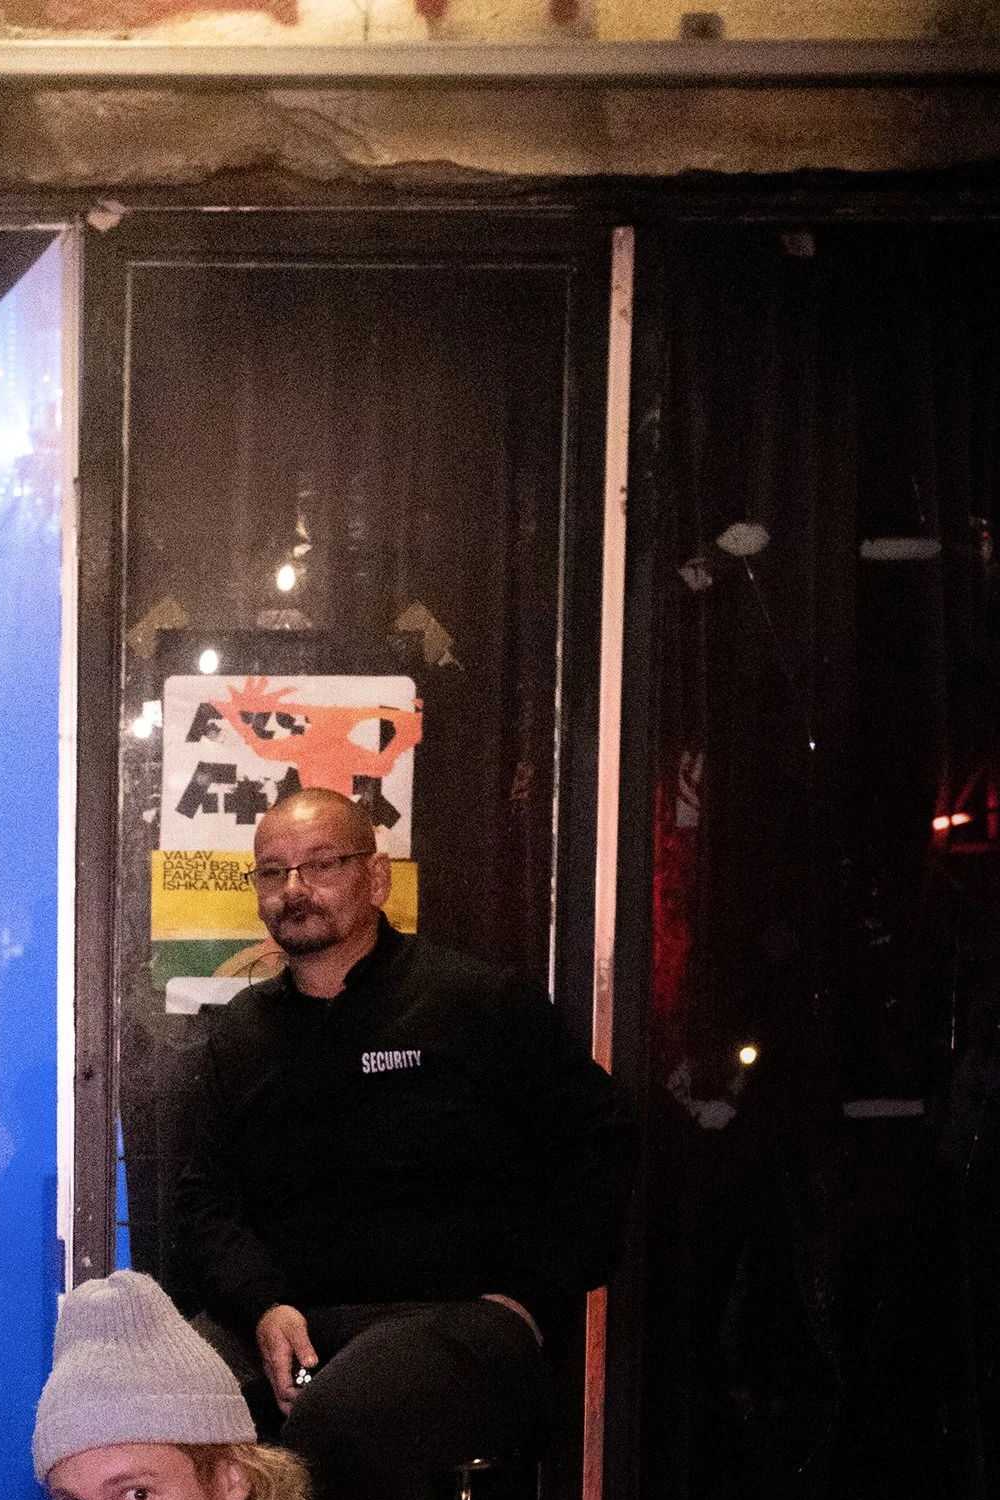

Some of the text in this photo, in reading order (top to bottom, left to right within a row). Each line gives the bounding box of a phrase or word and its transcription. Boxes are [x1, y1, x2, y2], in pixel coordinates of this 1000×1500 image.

[163, 850, 214, 860] VALAV
[163, 860, 206, 871] DASH
[210, 861, 240, 872] B2B
[163, 870, 204, 881] FAKE
[163, 880, 210, 891] ISHKA
[361, 1050, 421, 1073] SECURITY
